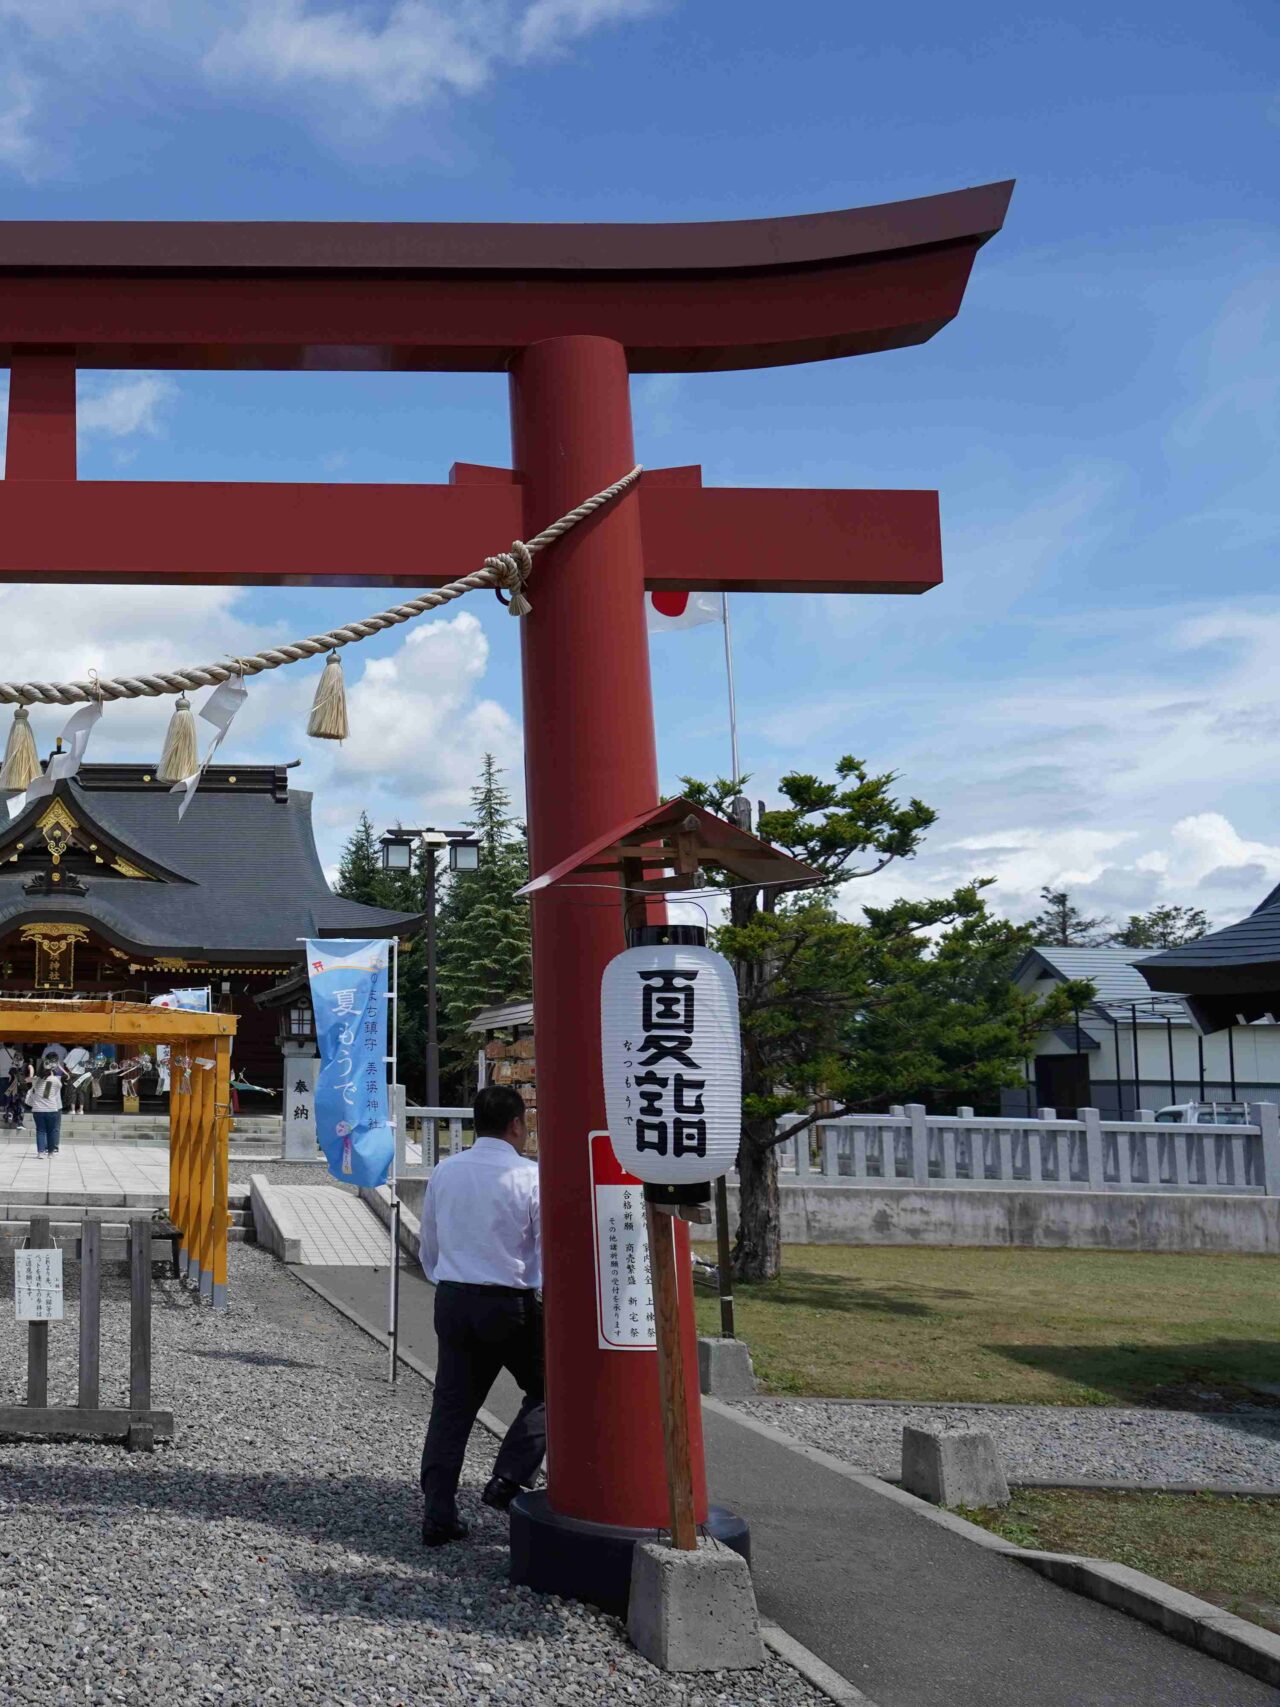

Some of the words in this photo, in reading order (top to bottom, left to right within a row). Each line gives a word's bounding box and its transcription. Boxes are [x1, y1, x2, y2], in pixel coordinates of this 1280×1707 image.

[332, 989, 361, 1105] 夏もうで
[634, 970, 707, 1157] 夏詣
[293, 1079, 309, 1120] 奉納
[623, 1040, 633, 1126] なつもうで
[623, 1190, 634, 1231] 合格祈願
[625, 1243, 637, 1285] 商売繁盛
[629, 1297, 639, 1337] 新宅祭
